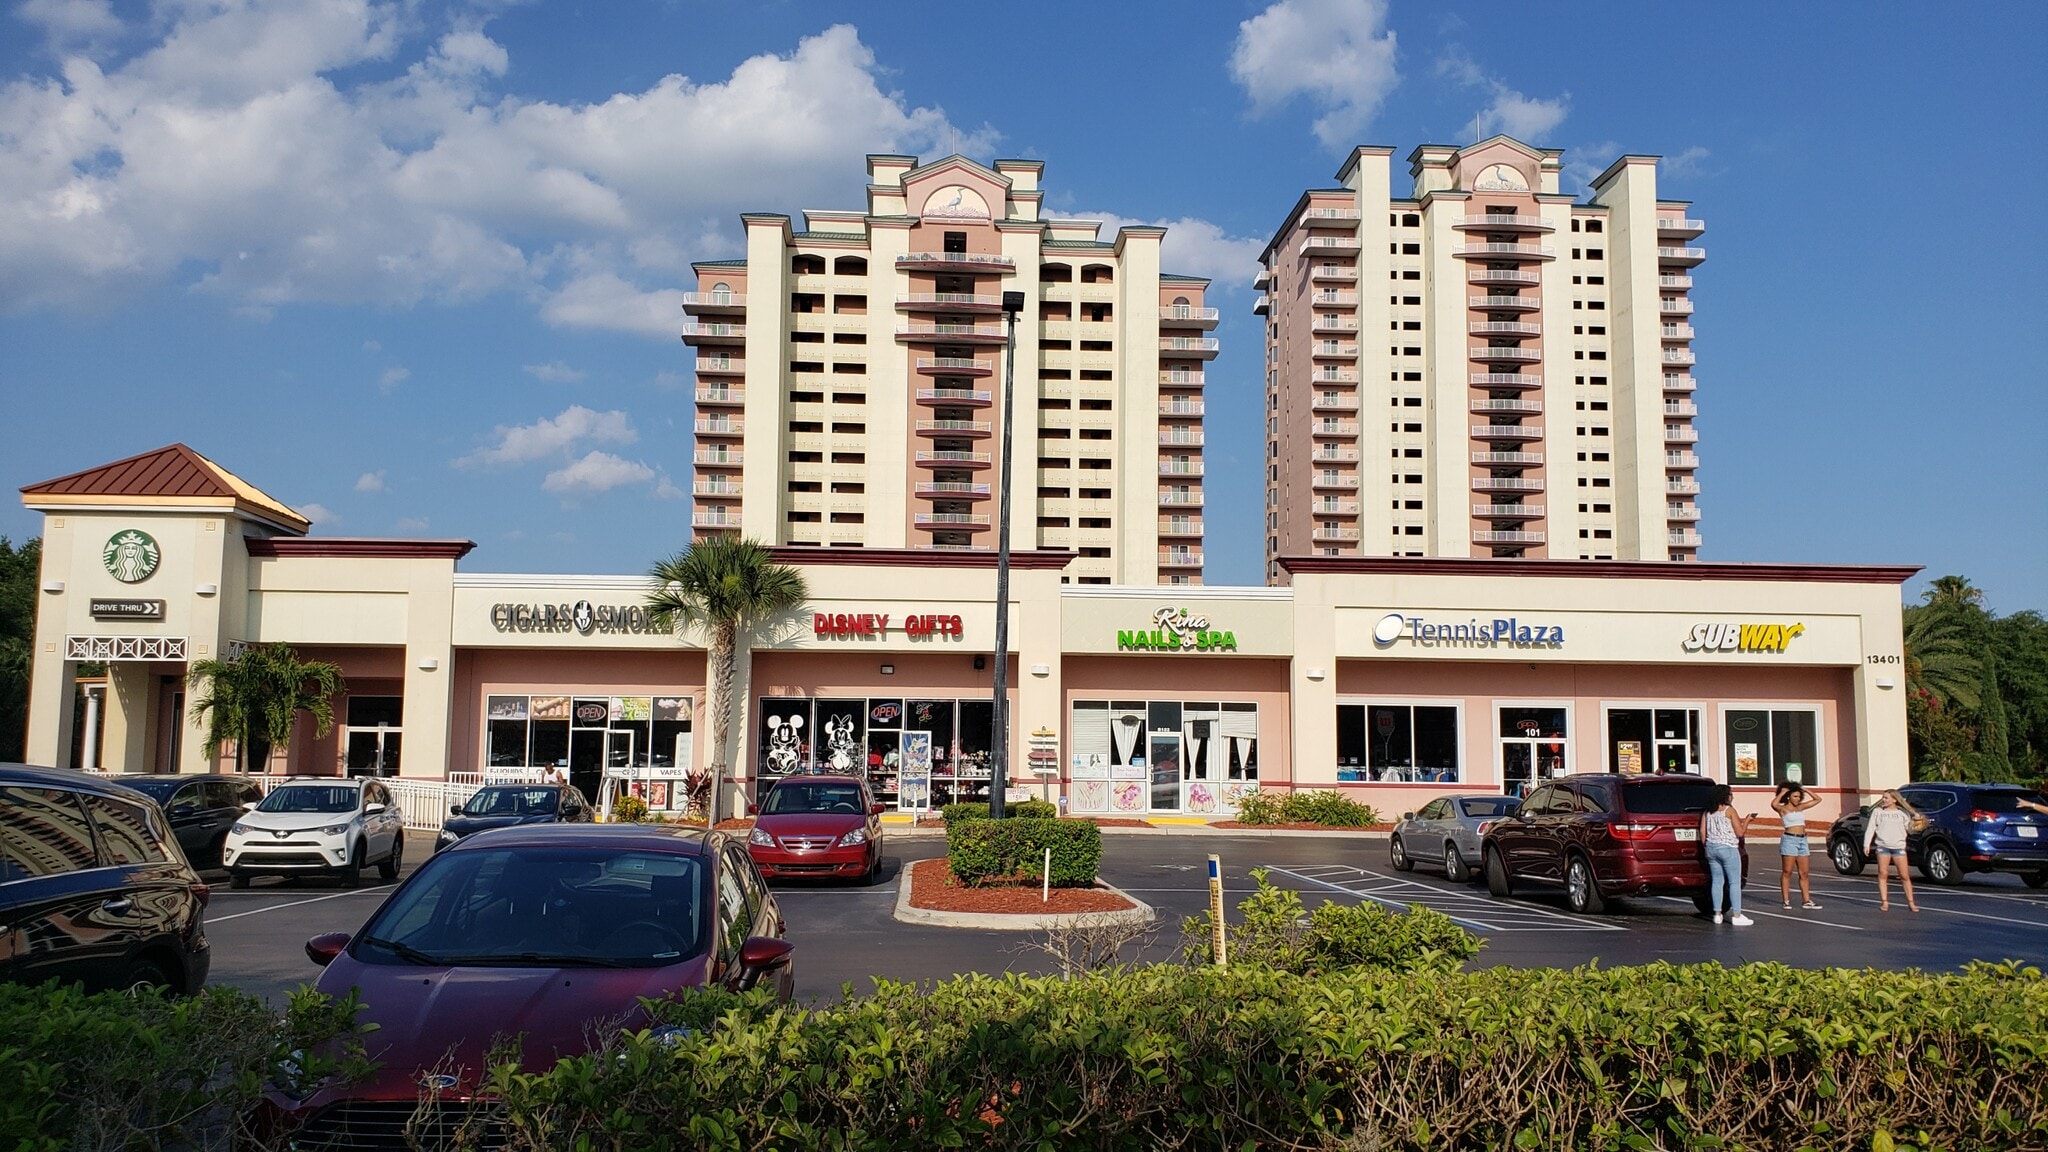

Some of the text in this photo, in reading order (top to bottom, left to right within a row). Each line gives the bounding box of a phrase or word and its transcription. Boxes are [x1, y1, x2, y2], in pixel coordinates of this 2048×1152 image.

[93, 604, 143, 612] DRIVE THRU
[490, 603, 572, 629] CIGARS
[814, 613, 964, 635] DISNEY GIFTS
[1153, 605, 1209, 636] Rina
[1117, 630, 1238, 648] NAILS & SPA
[1407, 617, 1565, 643] TennisPlaza
[1682, 622, 1806, 650] SUBWAY
[1866, 655, 1901, 665] 13401
[577, 707, 602, 718] OPEN
[872, 706, 899, 718] OPEN
[1525, 728, 1540, 737] 101
